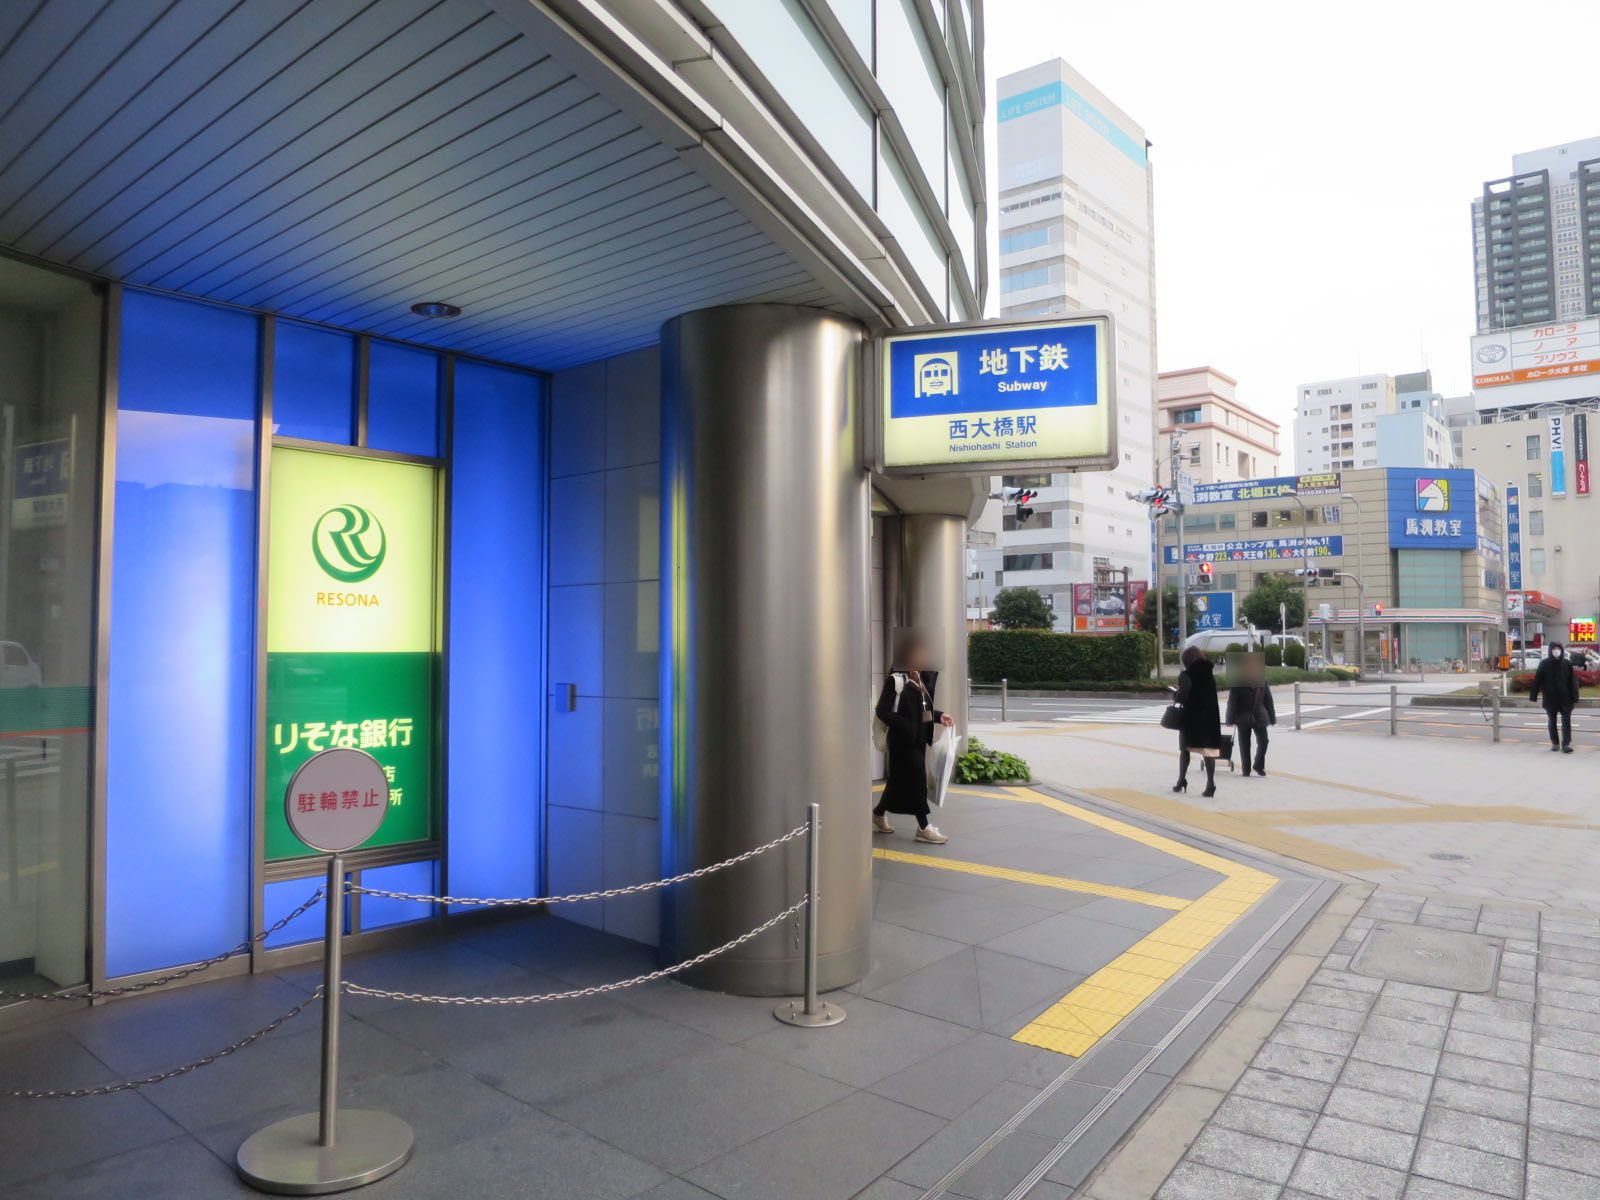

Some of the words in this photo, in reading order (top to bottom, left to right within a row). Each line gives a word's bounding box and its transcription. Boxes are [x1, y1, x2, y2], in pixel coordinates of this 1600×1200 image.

[1533, 323, 1577, 338] カローラ
[979, 343, 1069, 376] 地下鉄
[997, 380, 1048, 393] Subway
[1475, 375, 1511, 385] COROLLA
[949, 415, 1037, 440] 西大橋駅
[949, 442, 1001, 453] Nishiohashi
[1005, 440, 1037, 449] Station
[1405, 518, 1462, 538] 馬渕教室
[316, 591, 379, 607] RESONA
[274, 718, 413, 754] りそな銀行
[298, 789, 379, 813] 駐輪禁止
